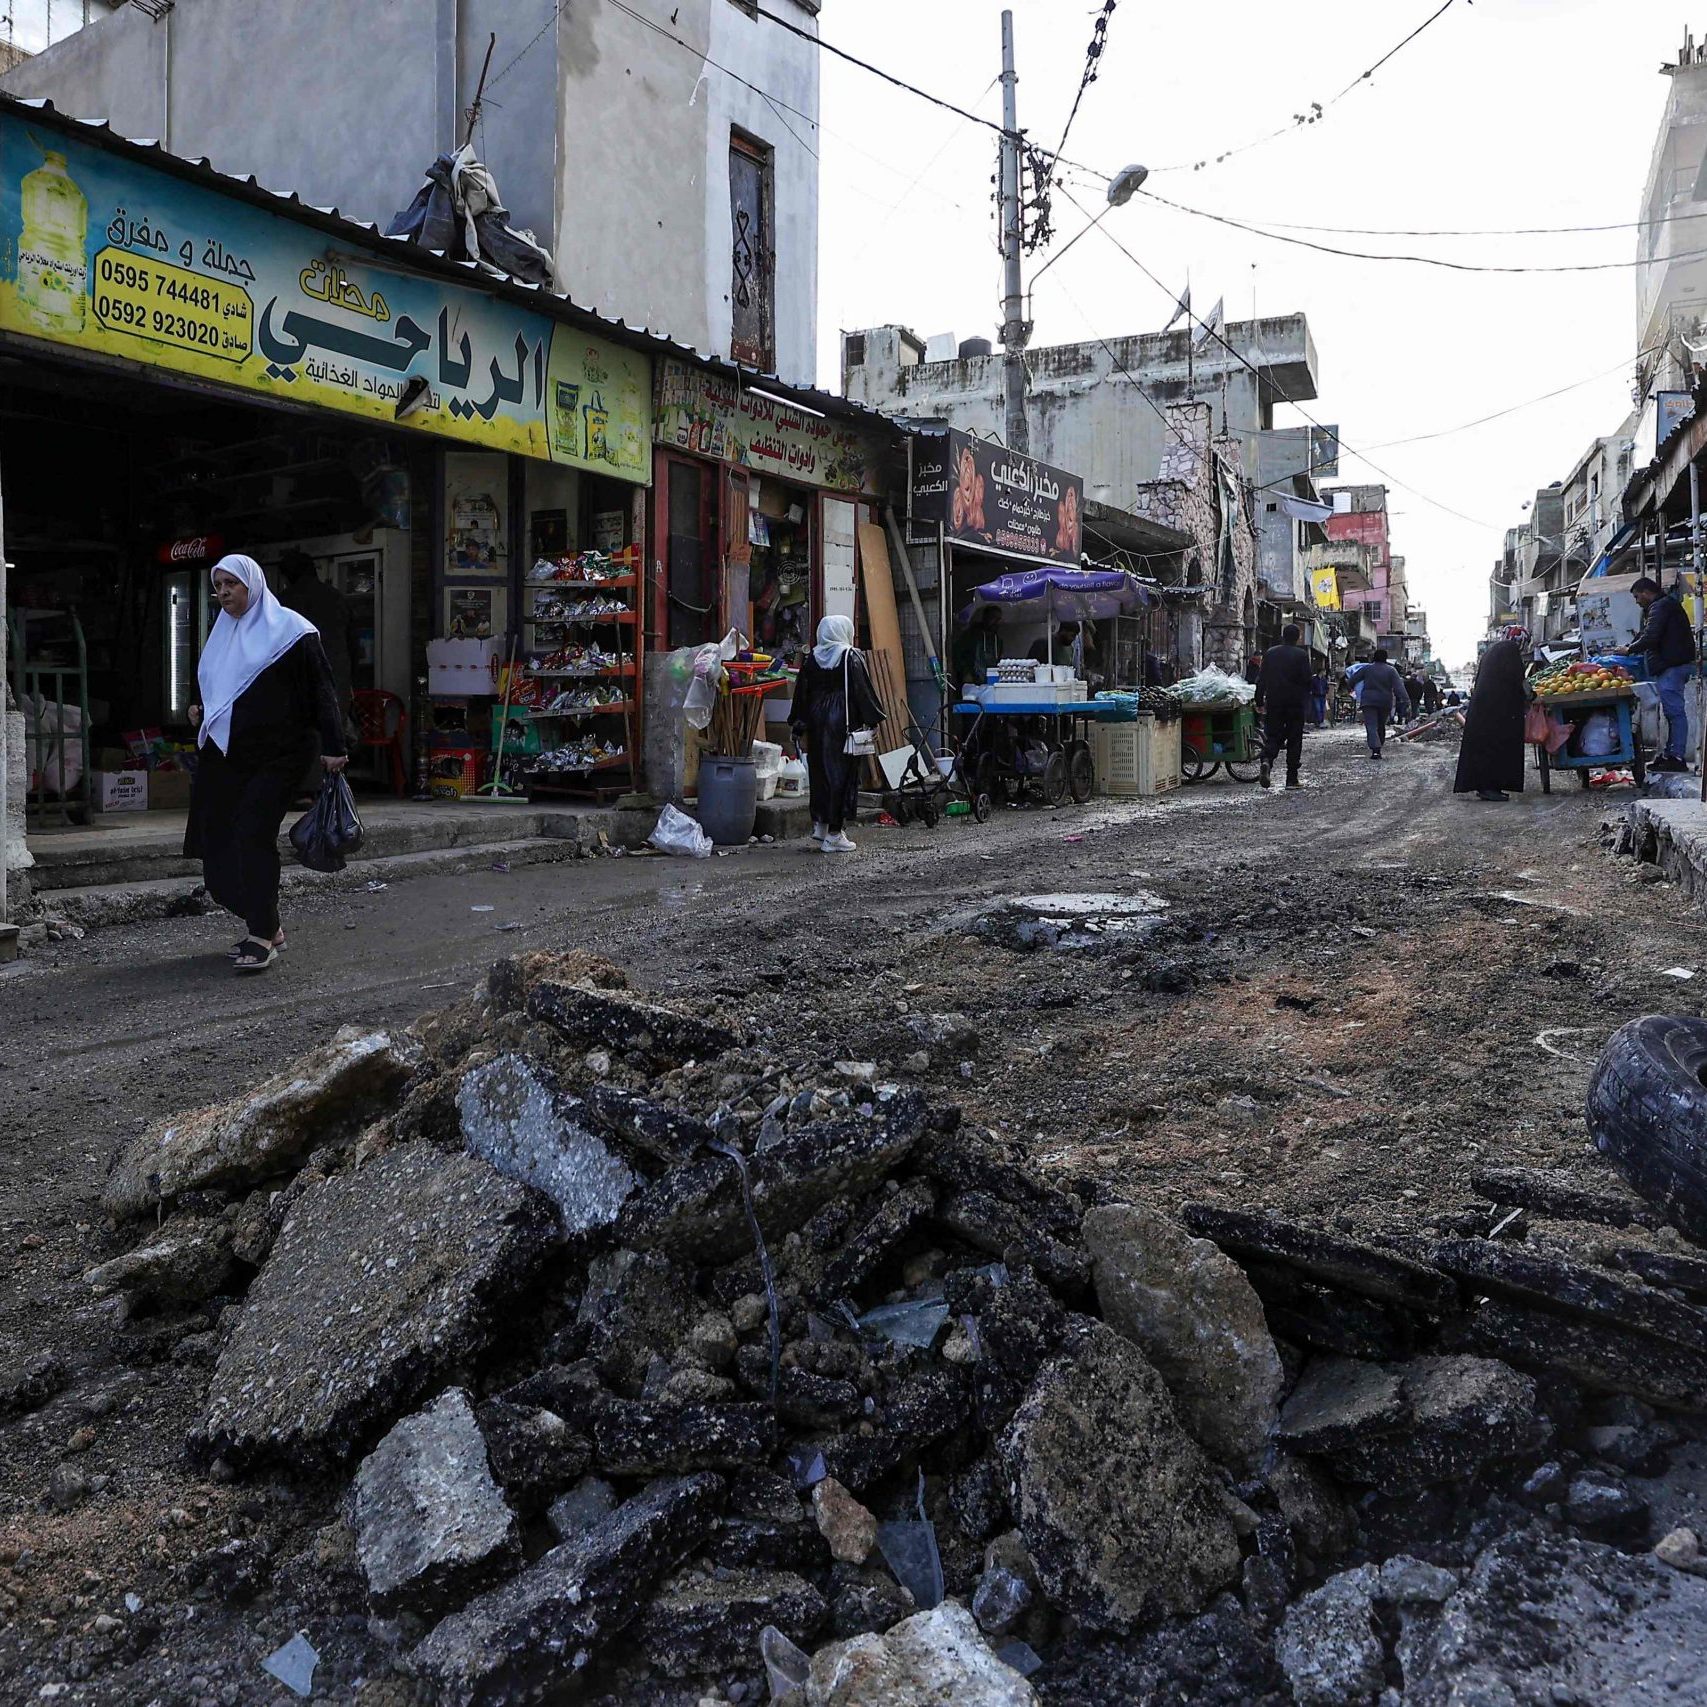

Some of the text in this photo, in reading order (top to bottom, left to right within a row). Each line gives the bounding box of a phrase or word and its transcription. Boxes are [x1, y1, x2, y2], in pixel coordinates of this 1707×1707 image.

[107, 208, 256, 286] جملة و مفرق
[101, 259, 247, 320] شادي 0595 744481
[299, 259, 390, 322] محلات
[99, 296, 146, 328] 0592
[152, 311, 219, 347] 923020
[221, 331, 248, 351] صادق
[258, 295, 543, 421] الرياحي
[305, 357, 358, 388] الغذائية
[363, 376, 403, 400] المواد
[749, 430, 787, 461] التنظيف
[918, 462, 943, 478] مخبز
[991, 460, 1060, 504] مخبز الكعبي
[913, 479, 949, 497] الكعبي
